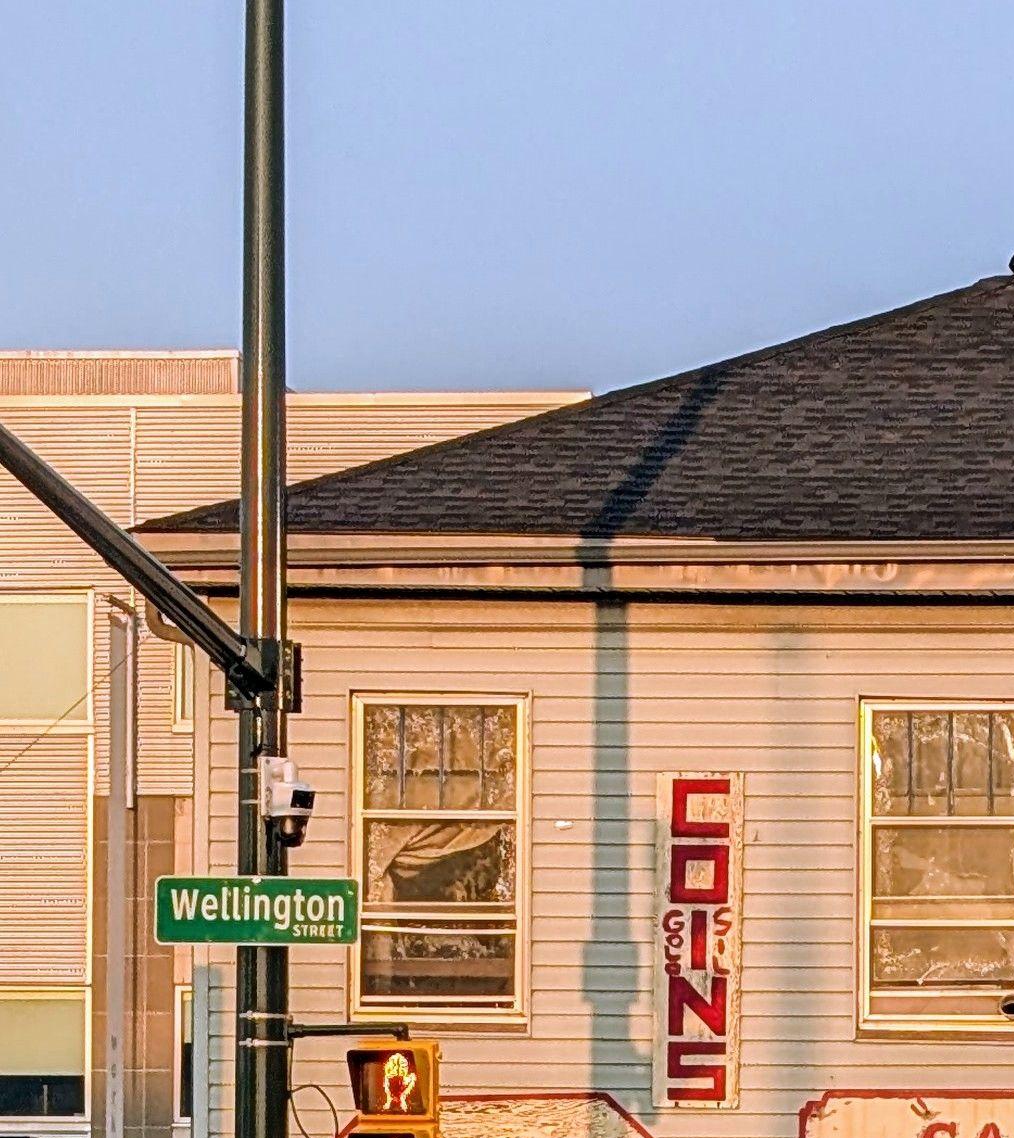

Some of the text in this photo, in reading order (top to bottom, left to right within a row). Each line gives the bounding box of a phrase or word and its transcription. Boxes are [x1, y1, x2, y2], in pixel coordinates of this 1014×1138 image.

[171, 886, 345, 930] Wellington
[292, 924, 344, 937] STREET
[667, 779, 730, 1101] COINS
